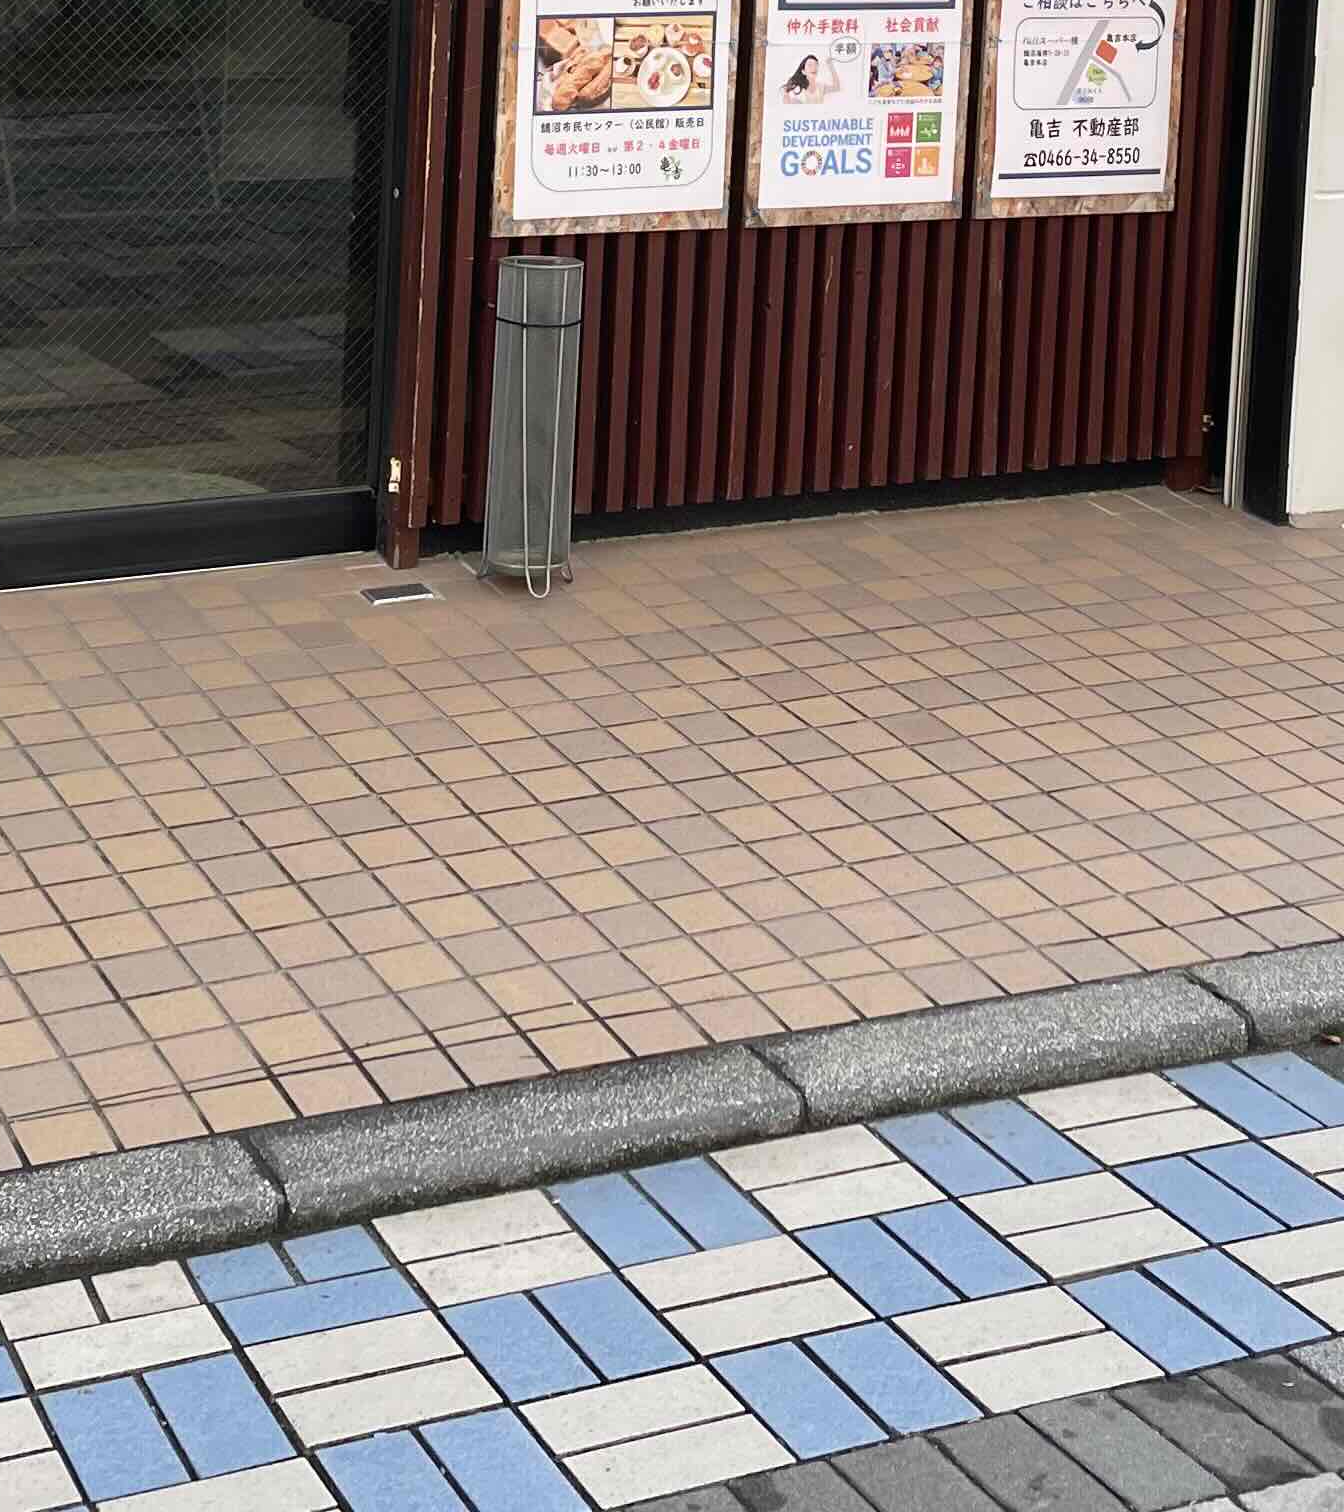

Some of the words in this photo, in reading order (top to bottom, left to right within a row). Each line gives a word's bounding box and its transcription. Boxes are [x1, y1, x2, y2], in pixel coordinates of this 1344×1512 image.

[786, 17, 860, 35] 仲介手数料
[884, 16, 941, 33] 社会貢献
[783, 118, 874, 133] SUSTAINABLE
[1072, 116, 1140, 138] 不動産部
[782, 133, 873, 148] DEVELOPMENT
[780, 148, 873, 177] GOALS
